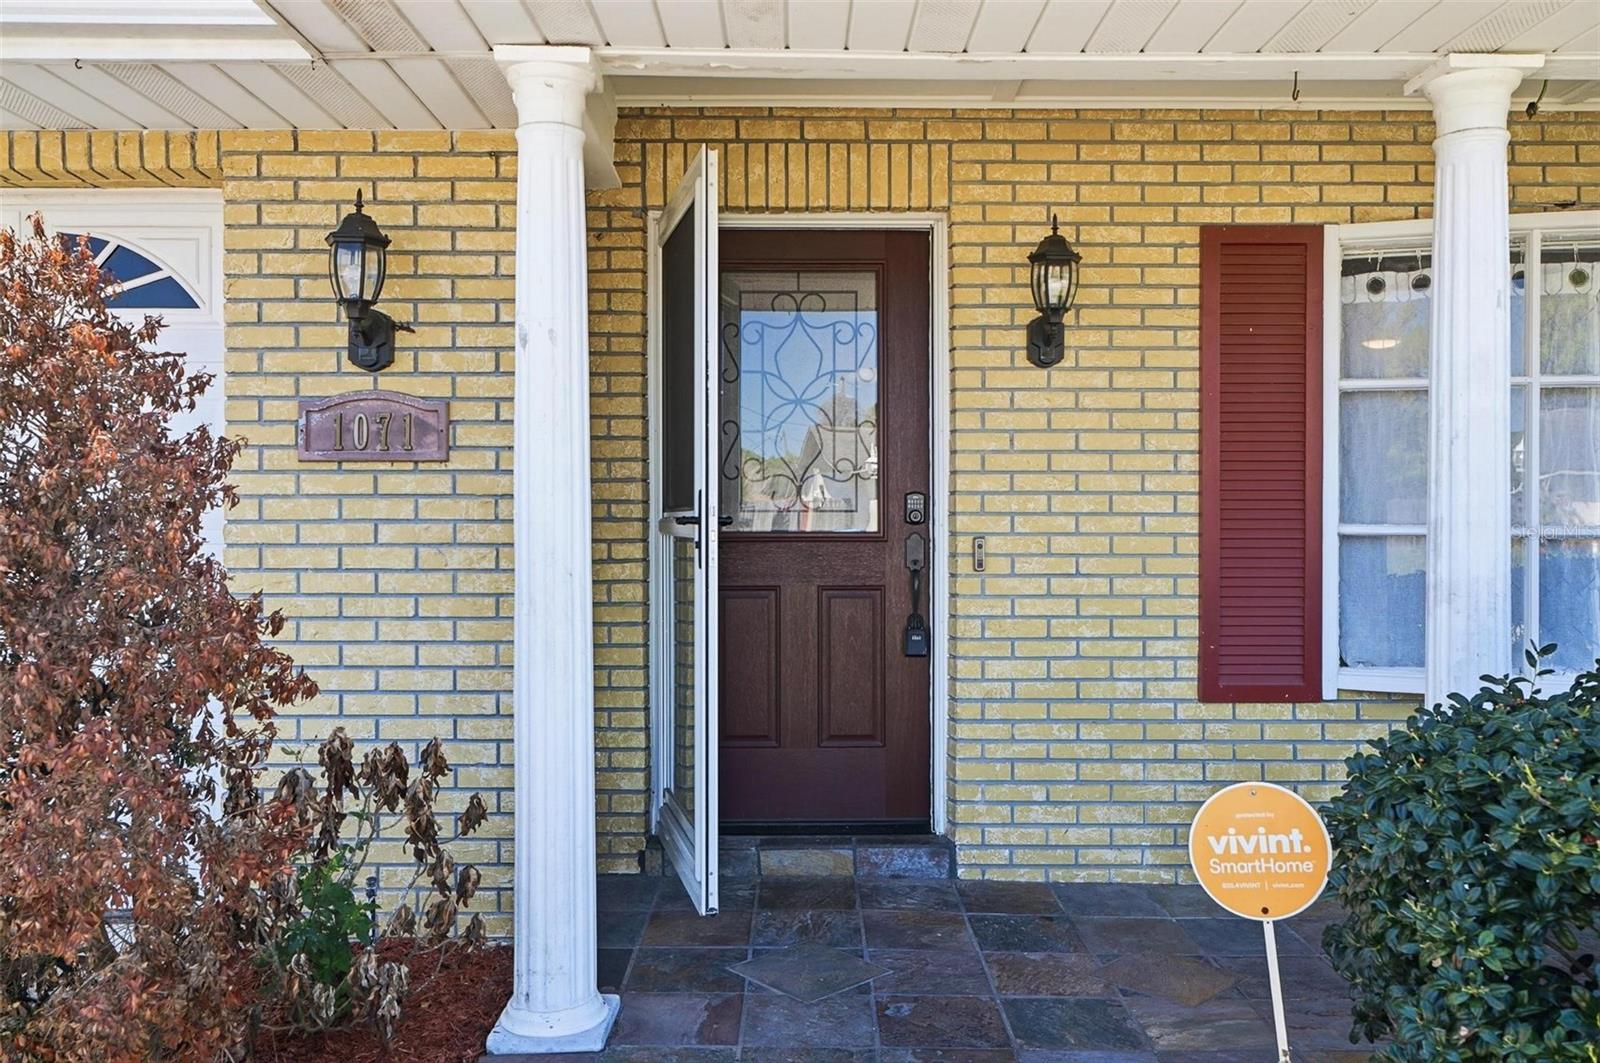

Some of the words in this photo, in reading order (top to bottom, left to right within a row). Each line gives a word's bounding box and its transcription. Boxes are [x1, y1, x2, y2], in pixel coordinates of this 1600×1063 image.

[333, 412, 413, 451] 1071
[1207, 827, 1312, 855] vivint.
[1209, 858, 1313, 874] SmartHome
